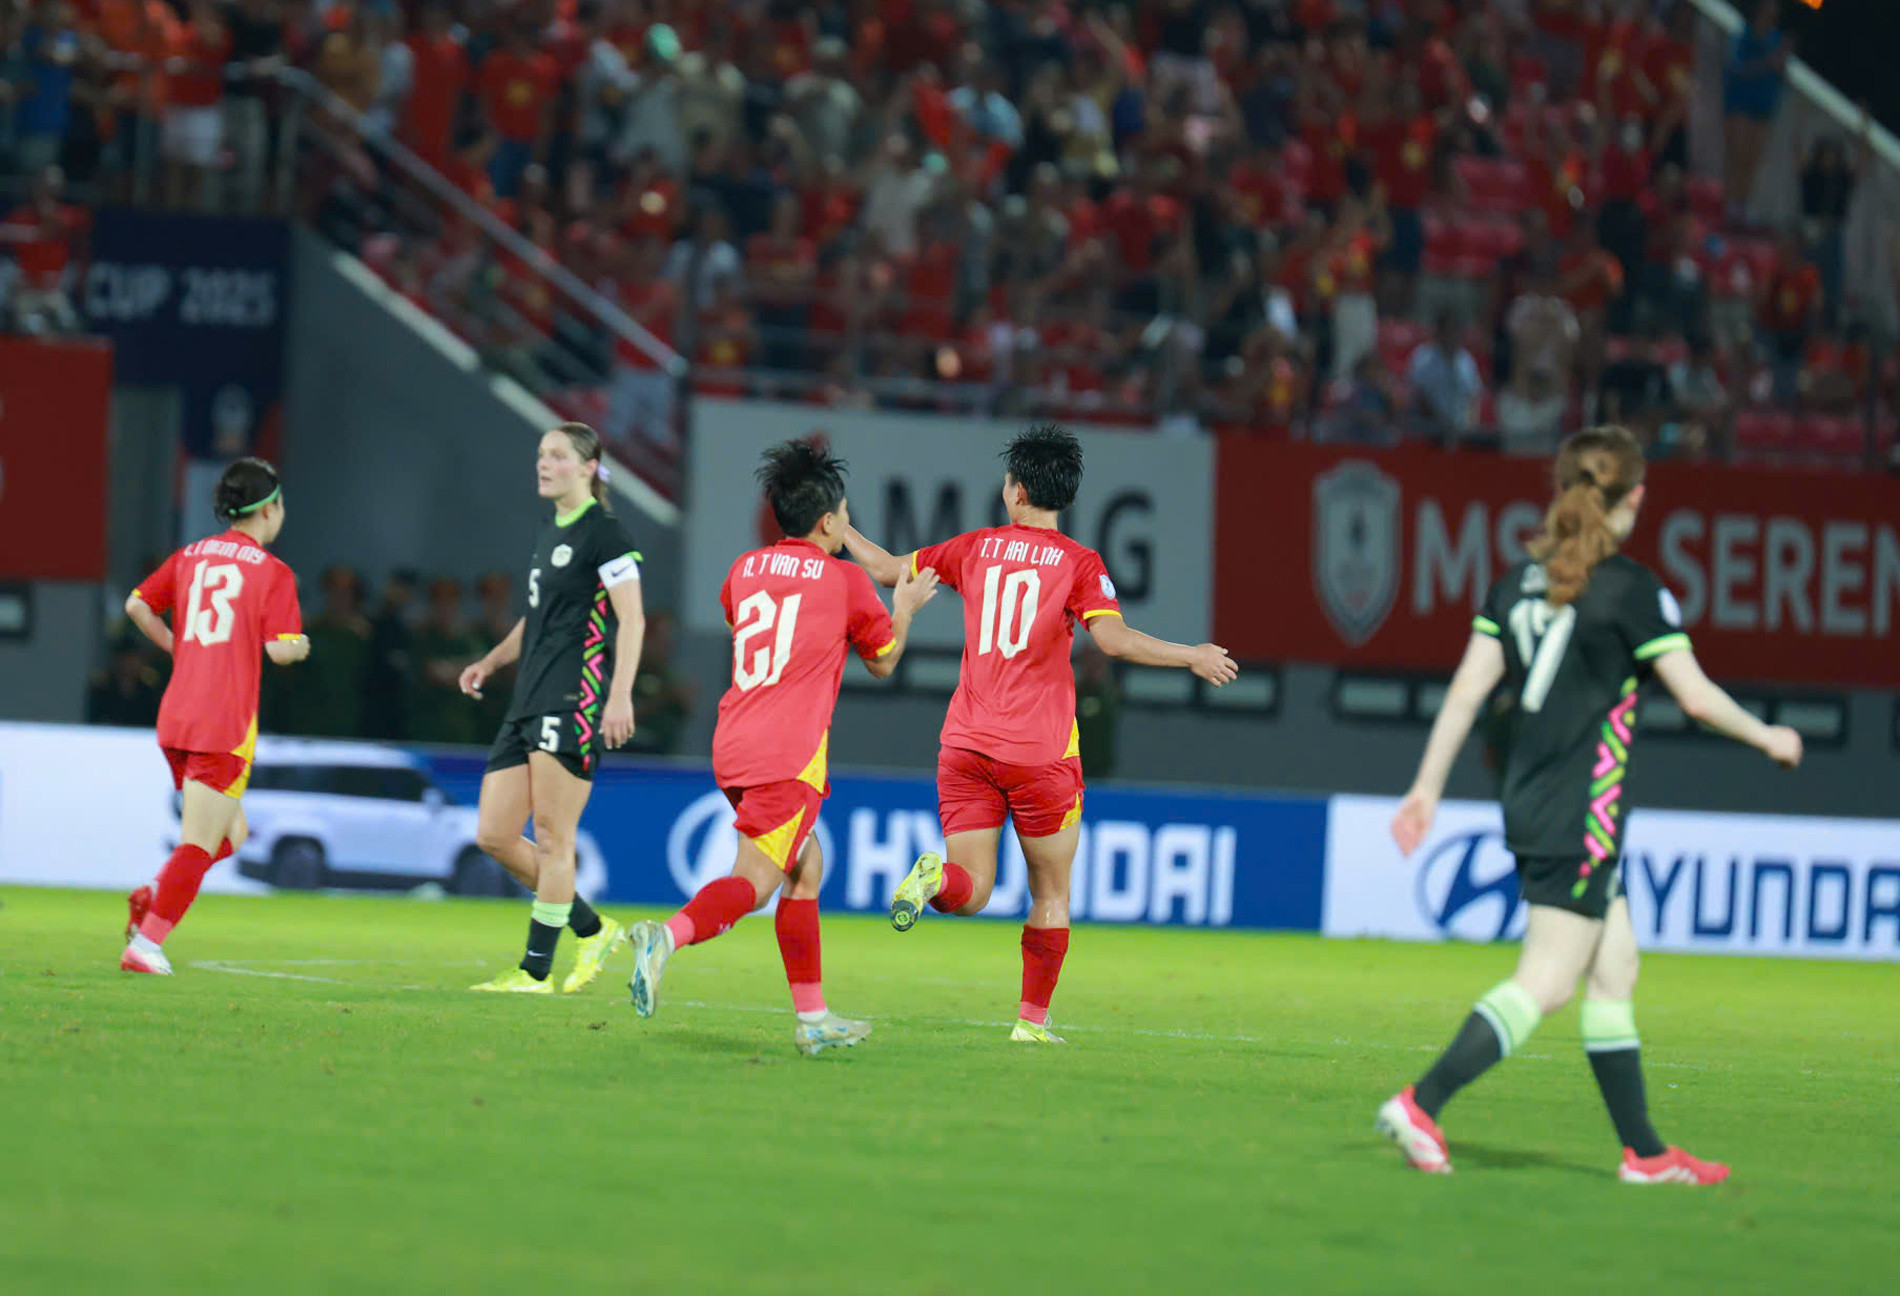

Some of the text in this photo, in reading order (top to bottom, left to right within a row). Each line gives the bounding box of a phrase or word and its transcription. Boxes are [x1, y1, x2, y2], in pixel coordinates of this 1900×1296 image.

[87, 262, 168, 320] CUP
[770, 553, 800, 578] VAN
[801, 558, 824, 580] SU
[884, 474, 1156, 606] MG
[1003, 540, 1029, 562] HAI
[1030, 545, 1064, 566] LINH
[183, 559, 244, 647] 13
[528, 568, 541, 608] 5
[978, 564, 1041, 659] 10
[734, 589, 802, 692] 21
[538, 716, 562, 752] 5
[1621, 852, 1900, 943] YUNDA
